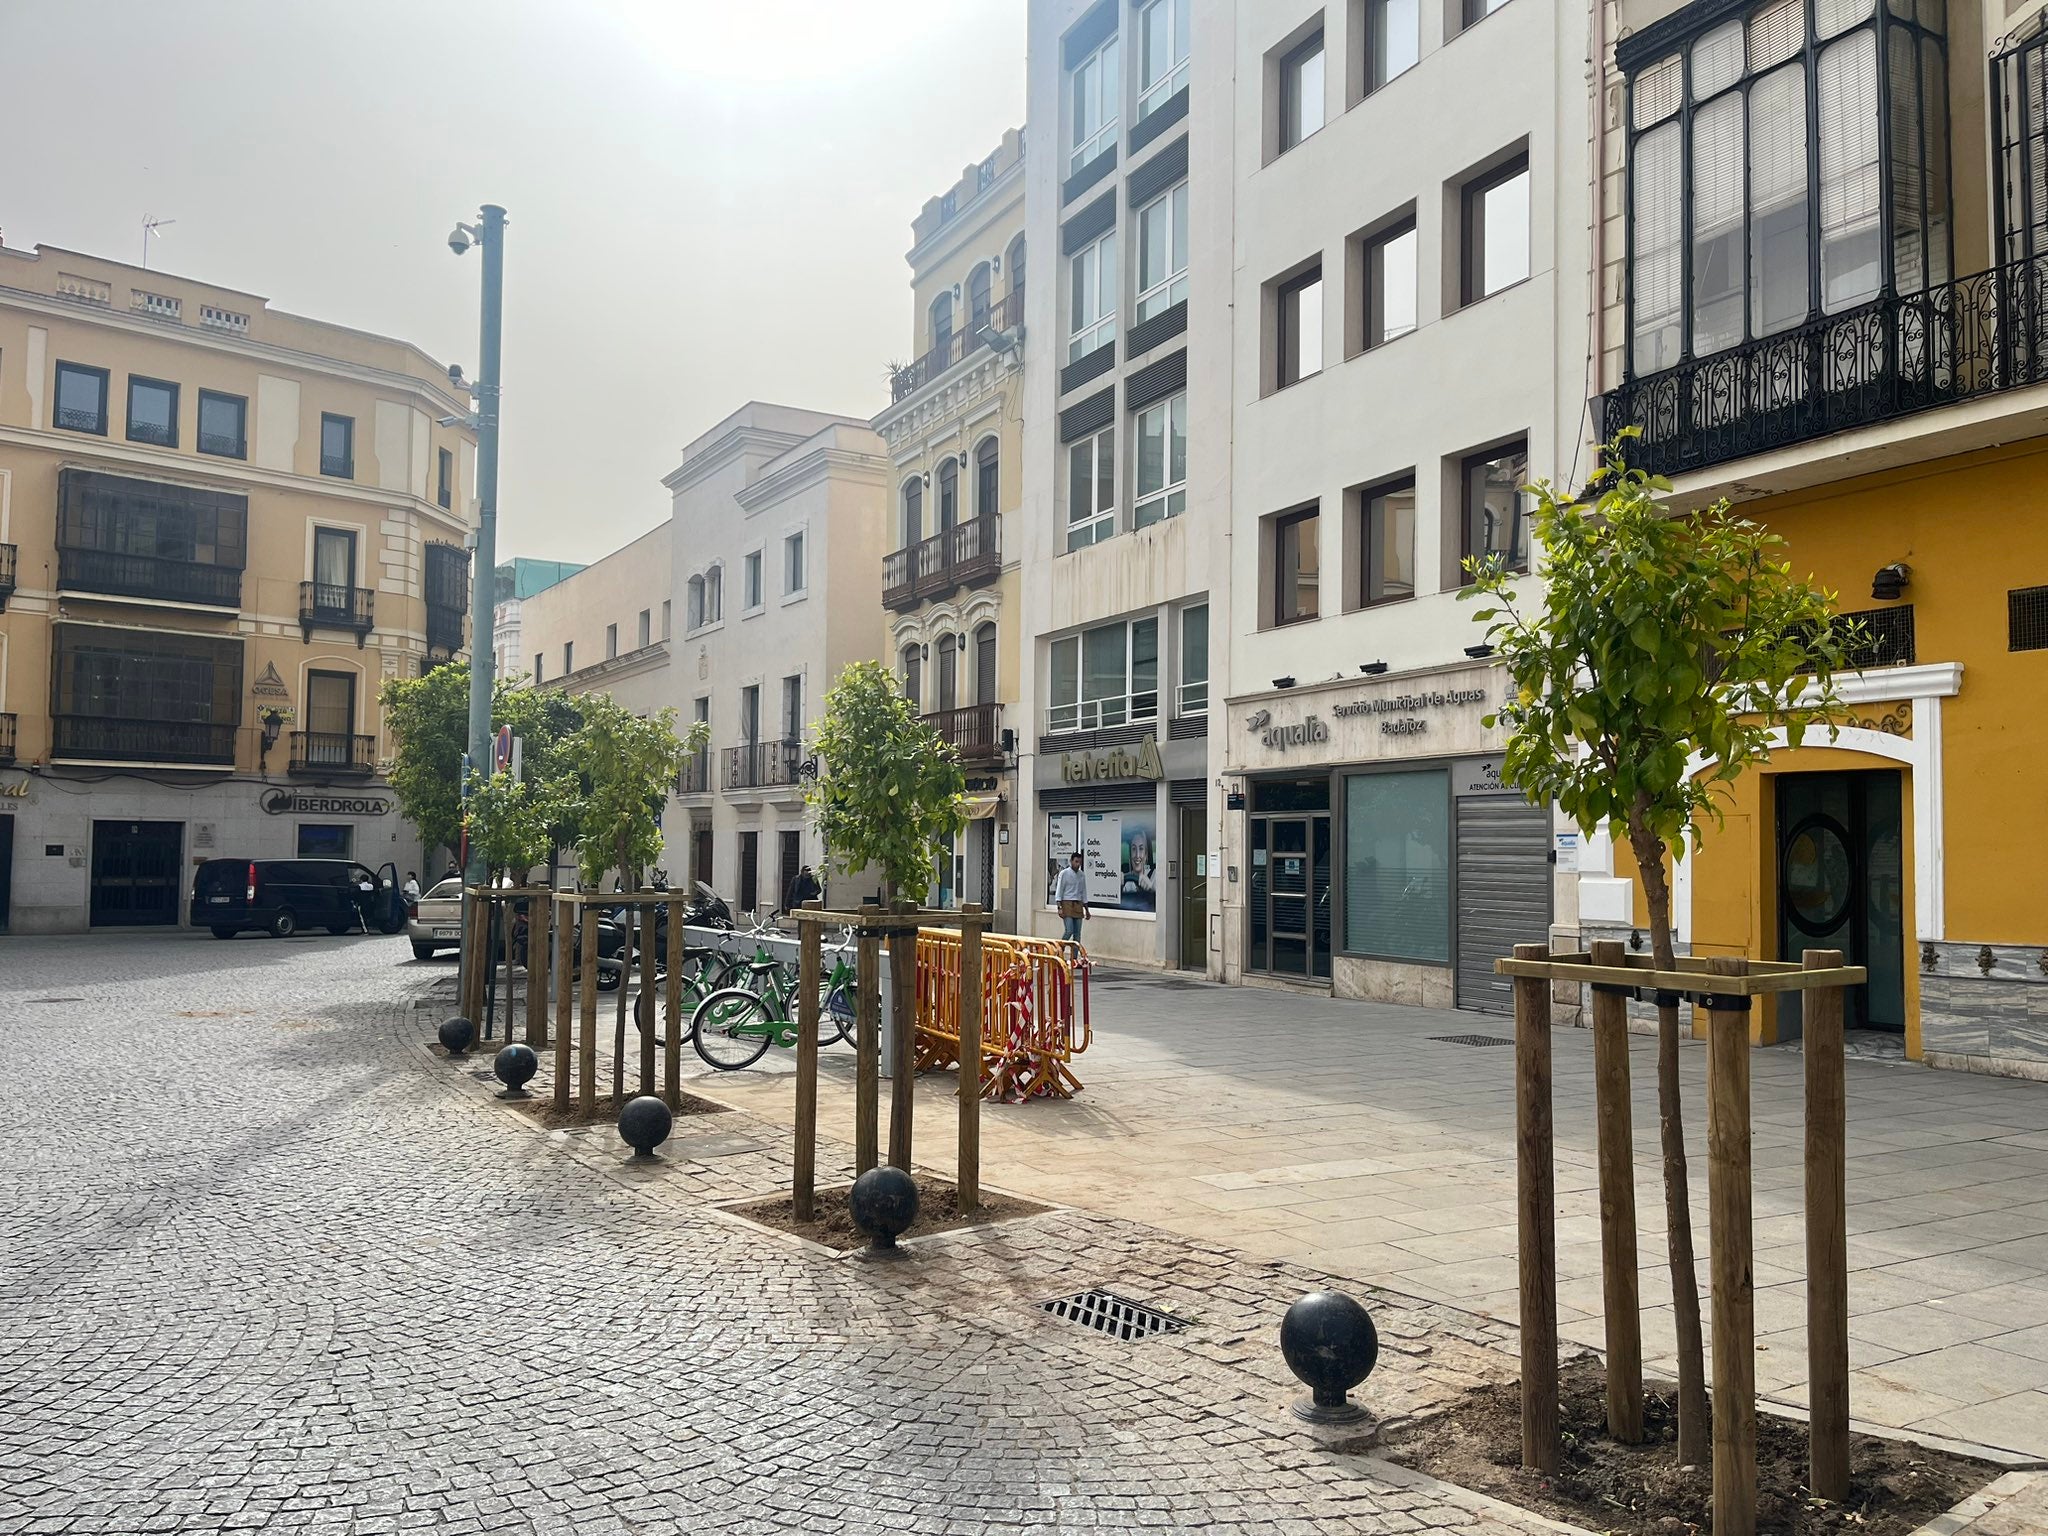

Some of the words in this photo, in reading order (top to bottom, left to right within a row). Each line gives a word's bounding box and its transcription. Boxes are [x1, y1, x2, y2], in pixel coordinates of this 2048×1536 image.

[1332, 700, 1371, 718] Servicio
[1371, 693, 1425, 713] Municipal
[1427, 691, 1445, 705] de
[1446, 688, 1485, 706] Aguas
[1261, 715, 1328, 752] aqualia
[1381, 718, 1426, 734] Badajoz
[1061, 747, 1137, 783] helvetia
[1469, 781, 1499, 791] ATENCIÓN
[292, 798, 383, 813] IBERDROLA
